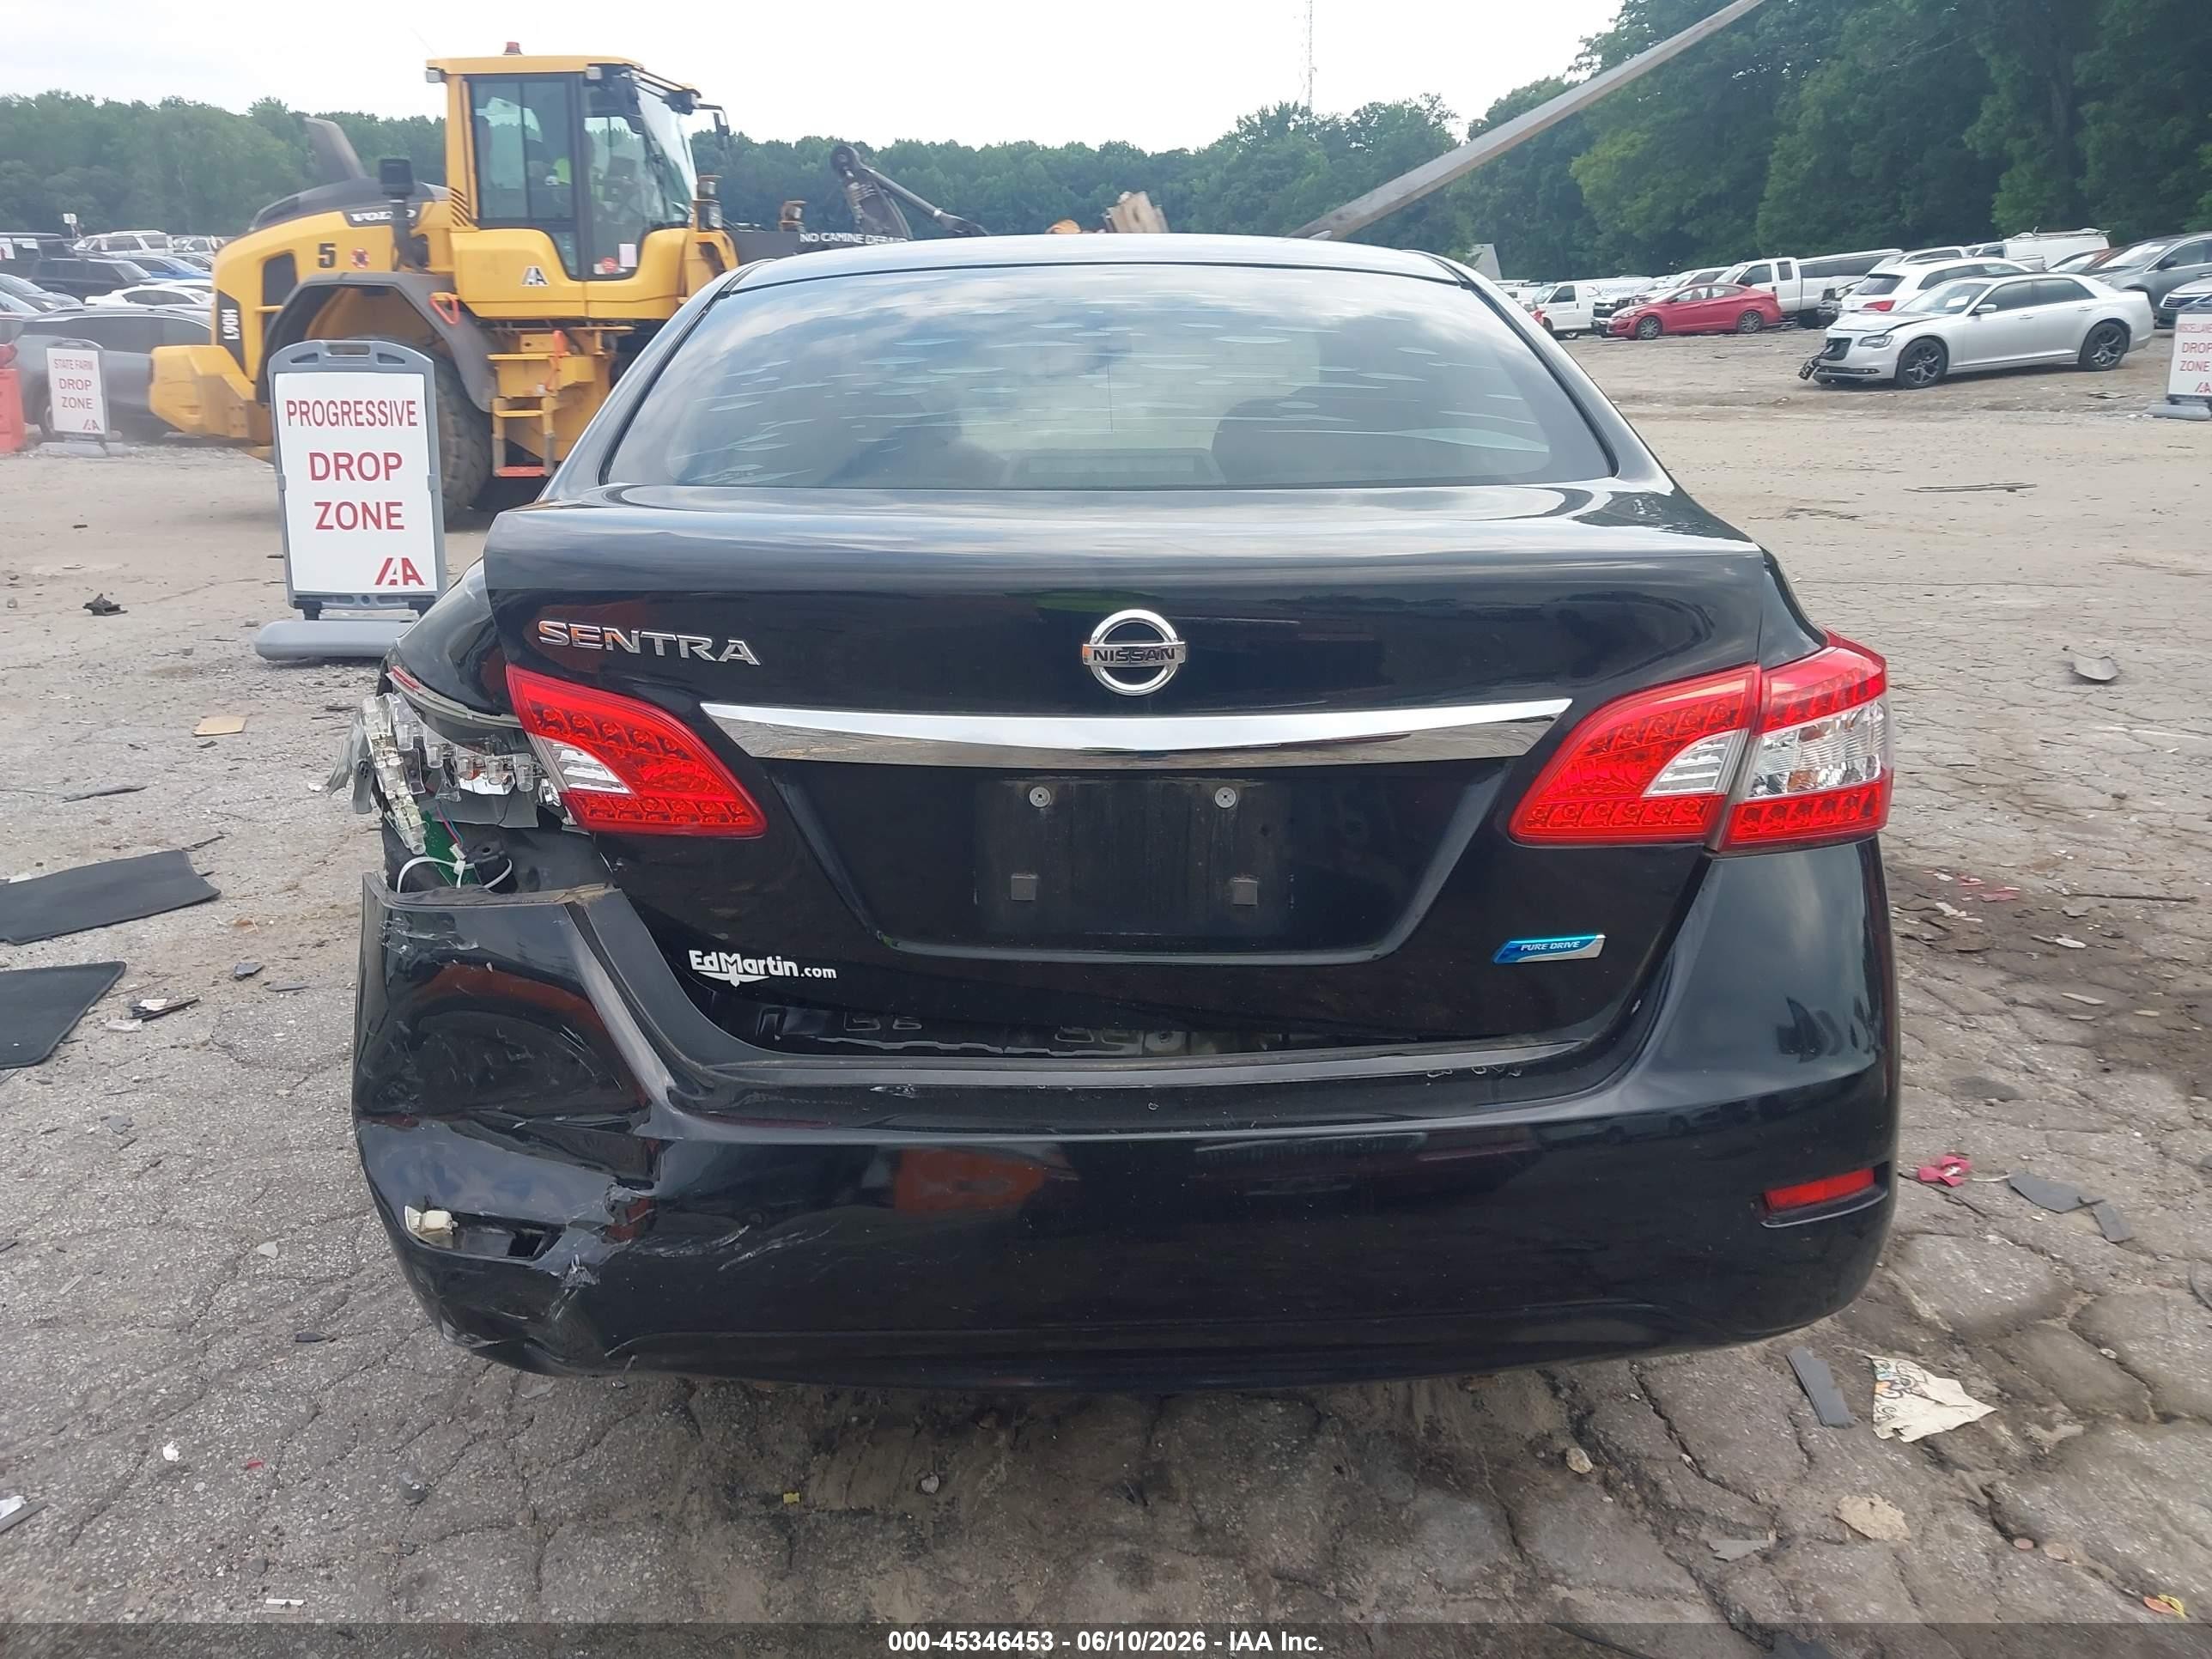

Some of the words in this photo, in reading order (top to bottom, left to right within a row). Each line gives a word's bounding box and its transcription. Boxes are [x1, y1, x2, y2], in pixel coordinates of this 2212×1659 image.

[350, 209, 416, 222] VOLO
[799, 233, 820, 243] NO
[318, 243, 337, 269] 5
[2179, 360, 2210, 372] ZONE
[58, 378, 92, 391] DROP
[61, 396, 94, 410] ZONE
[286, 400, 418, 427] PROGRESSIVE
[309, 452, 403, 481] DROP
[313, 501, 405, 531] ZONE
[538, 620, 762, 666] SENTRA
[1093, 647, 1176, 662] NISSAN
[1520, 943, 1547, 951] PURE
[1549, 941, 1581, 950] DRIVE
[688, 950, 837, 979] EdMartin.com
